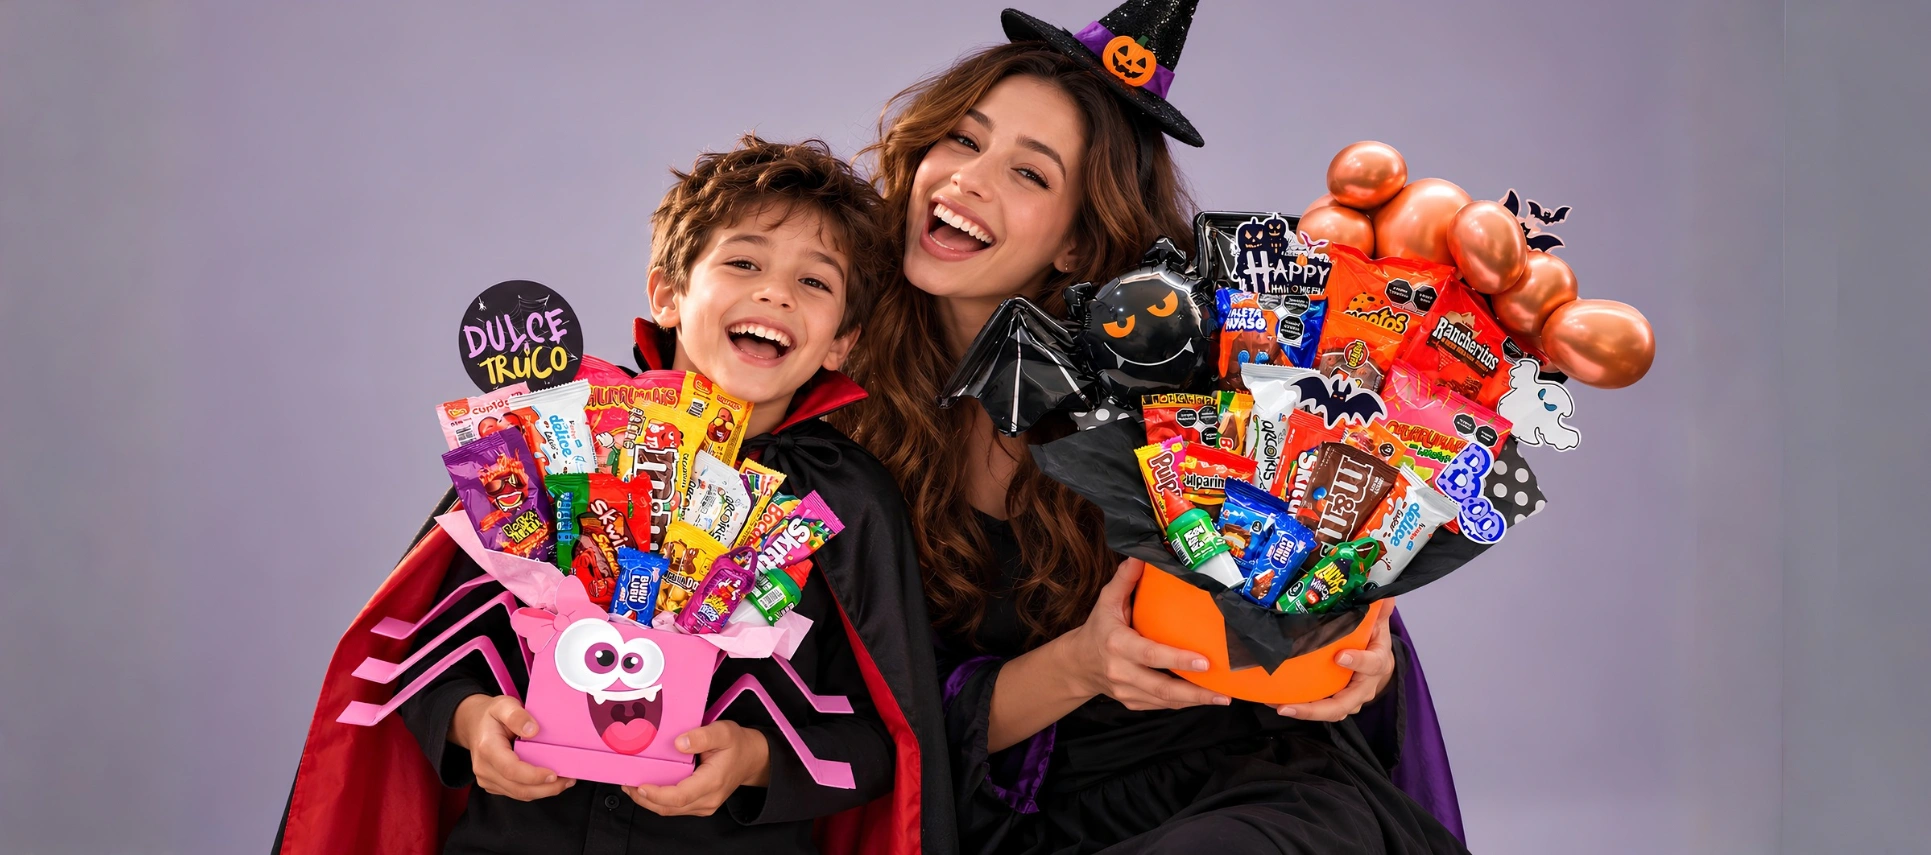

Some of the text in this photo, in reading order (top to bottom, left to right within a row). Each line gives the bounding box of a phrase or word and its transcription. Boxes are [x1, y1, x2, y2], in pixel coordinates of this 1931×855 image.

[1243, 251, 1330, 294] HAPPY
[463, 308, 567, 358] DULCE
[1432, 317, 1499, 371] Rancheritos
